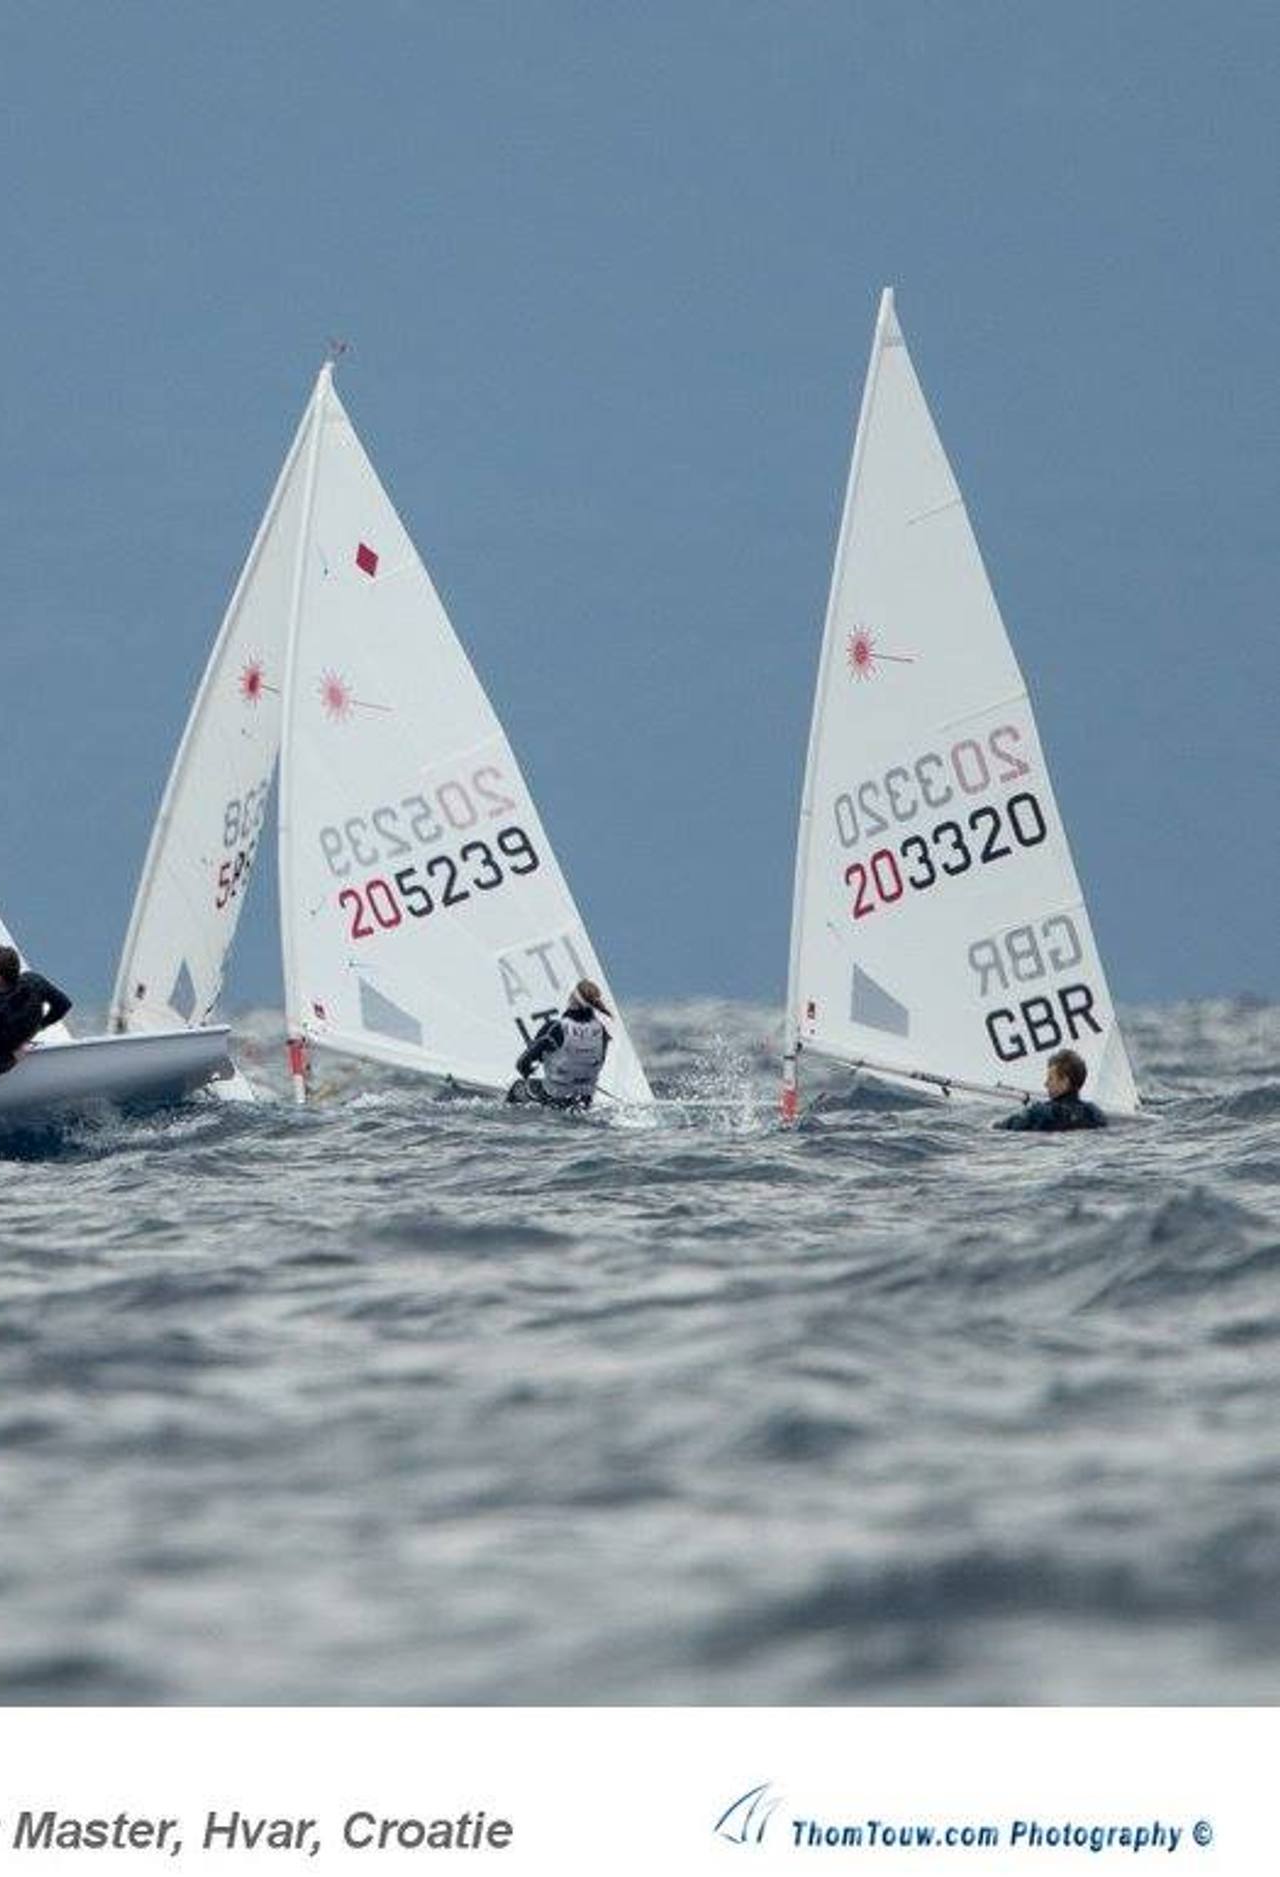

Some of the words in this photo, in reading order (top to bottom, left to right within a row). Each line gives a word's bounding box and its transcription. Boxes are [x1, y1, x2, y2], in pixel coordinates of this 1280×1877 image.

[339, 826, 541, 939] 205239
[844, 792, 1048, 920] 203320
[985, 983, 1103, 1062] GBR
